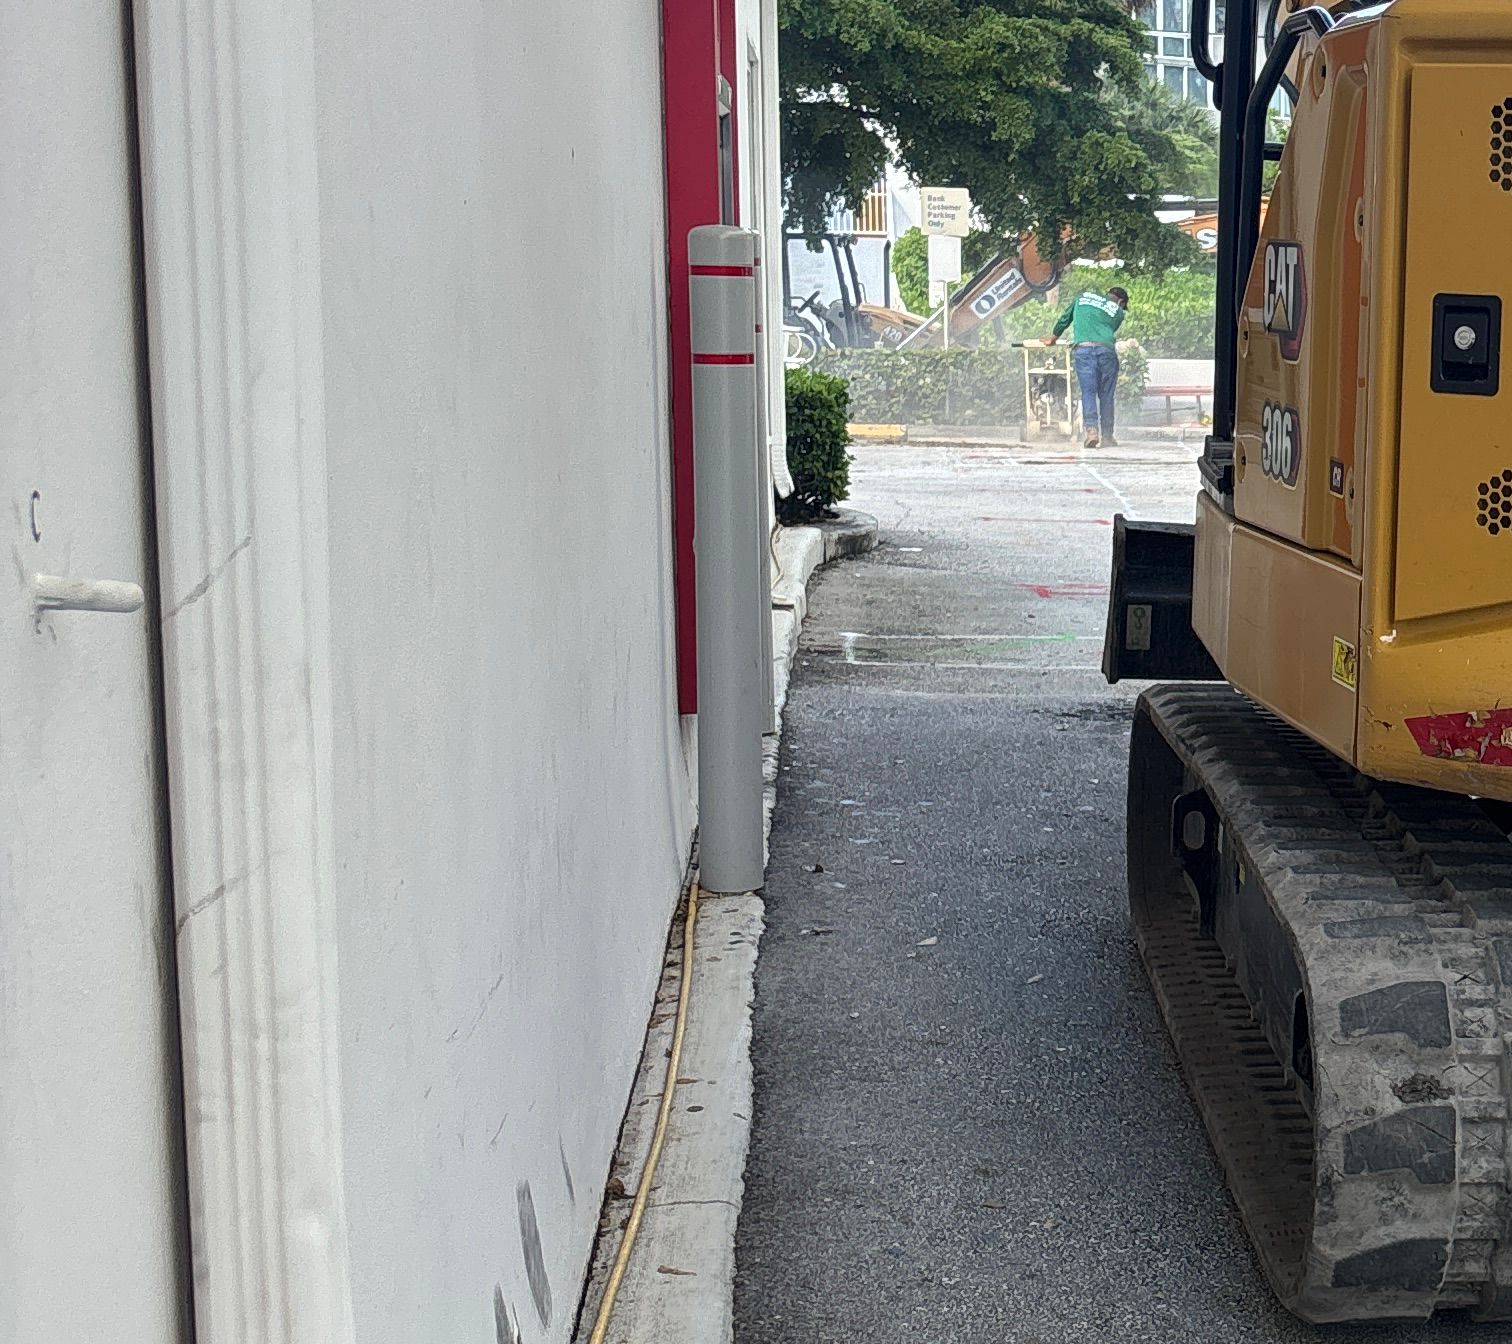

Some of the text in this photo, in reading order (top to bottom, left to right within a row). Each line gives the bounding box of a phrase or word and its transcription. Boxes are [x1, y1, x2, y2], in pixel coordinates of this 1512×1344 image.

[928, 203, 961, 211] Customer
[928, 212, 956, 220] Parking
[928, 220, 945, 228] Only
[1264, 244, 1297, 331] CAT
[1263, 405, 1292, 479] 306
